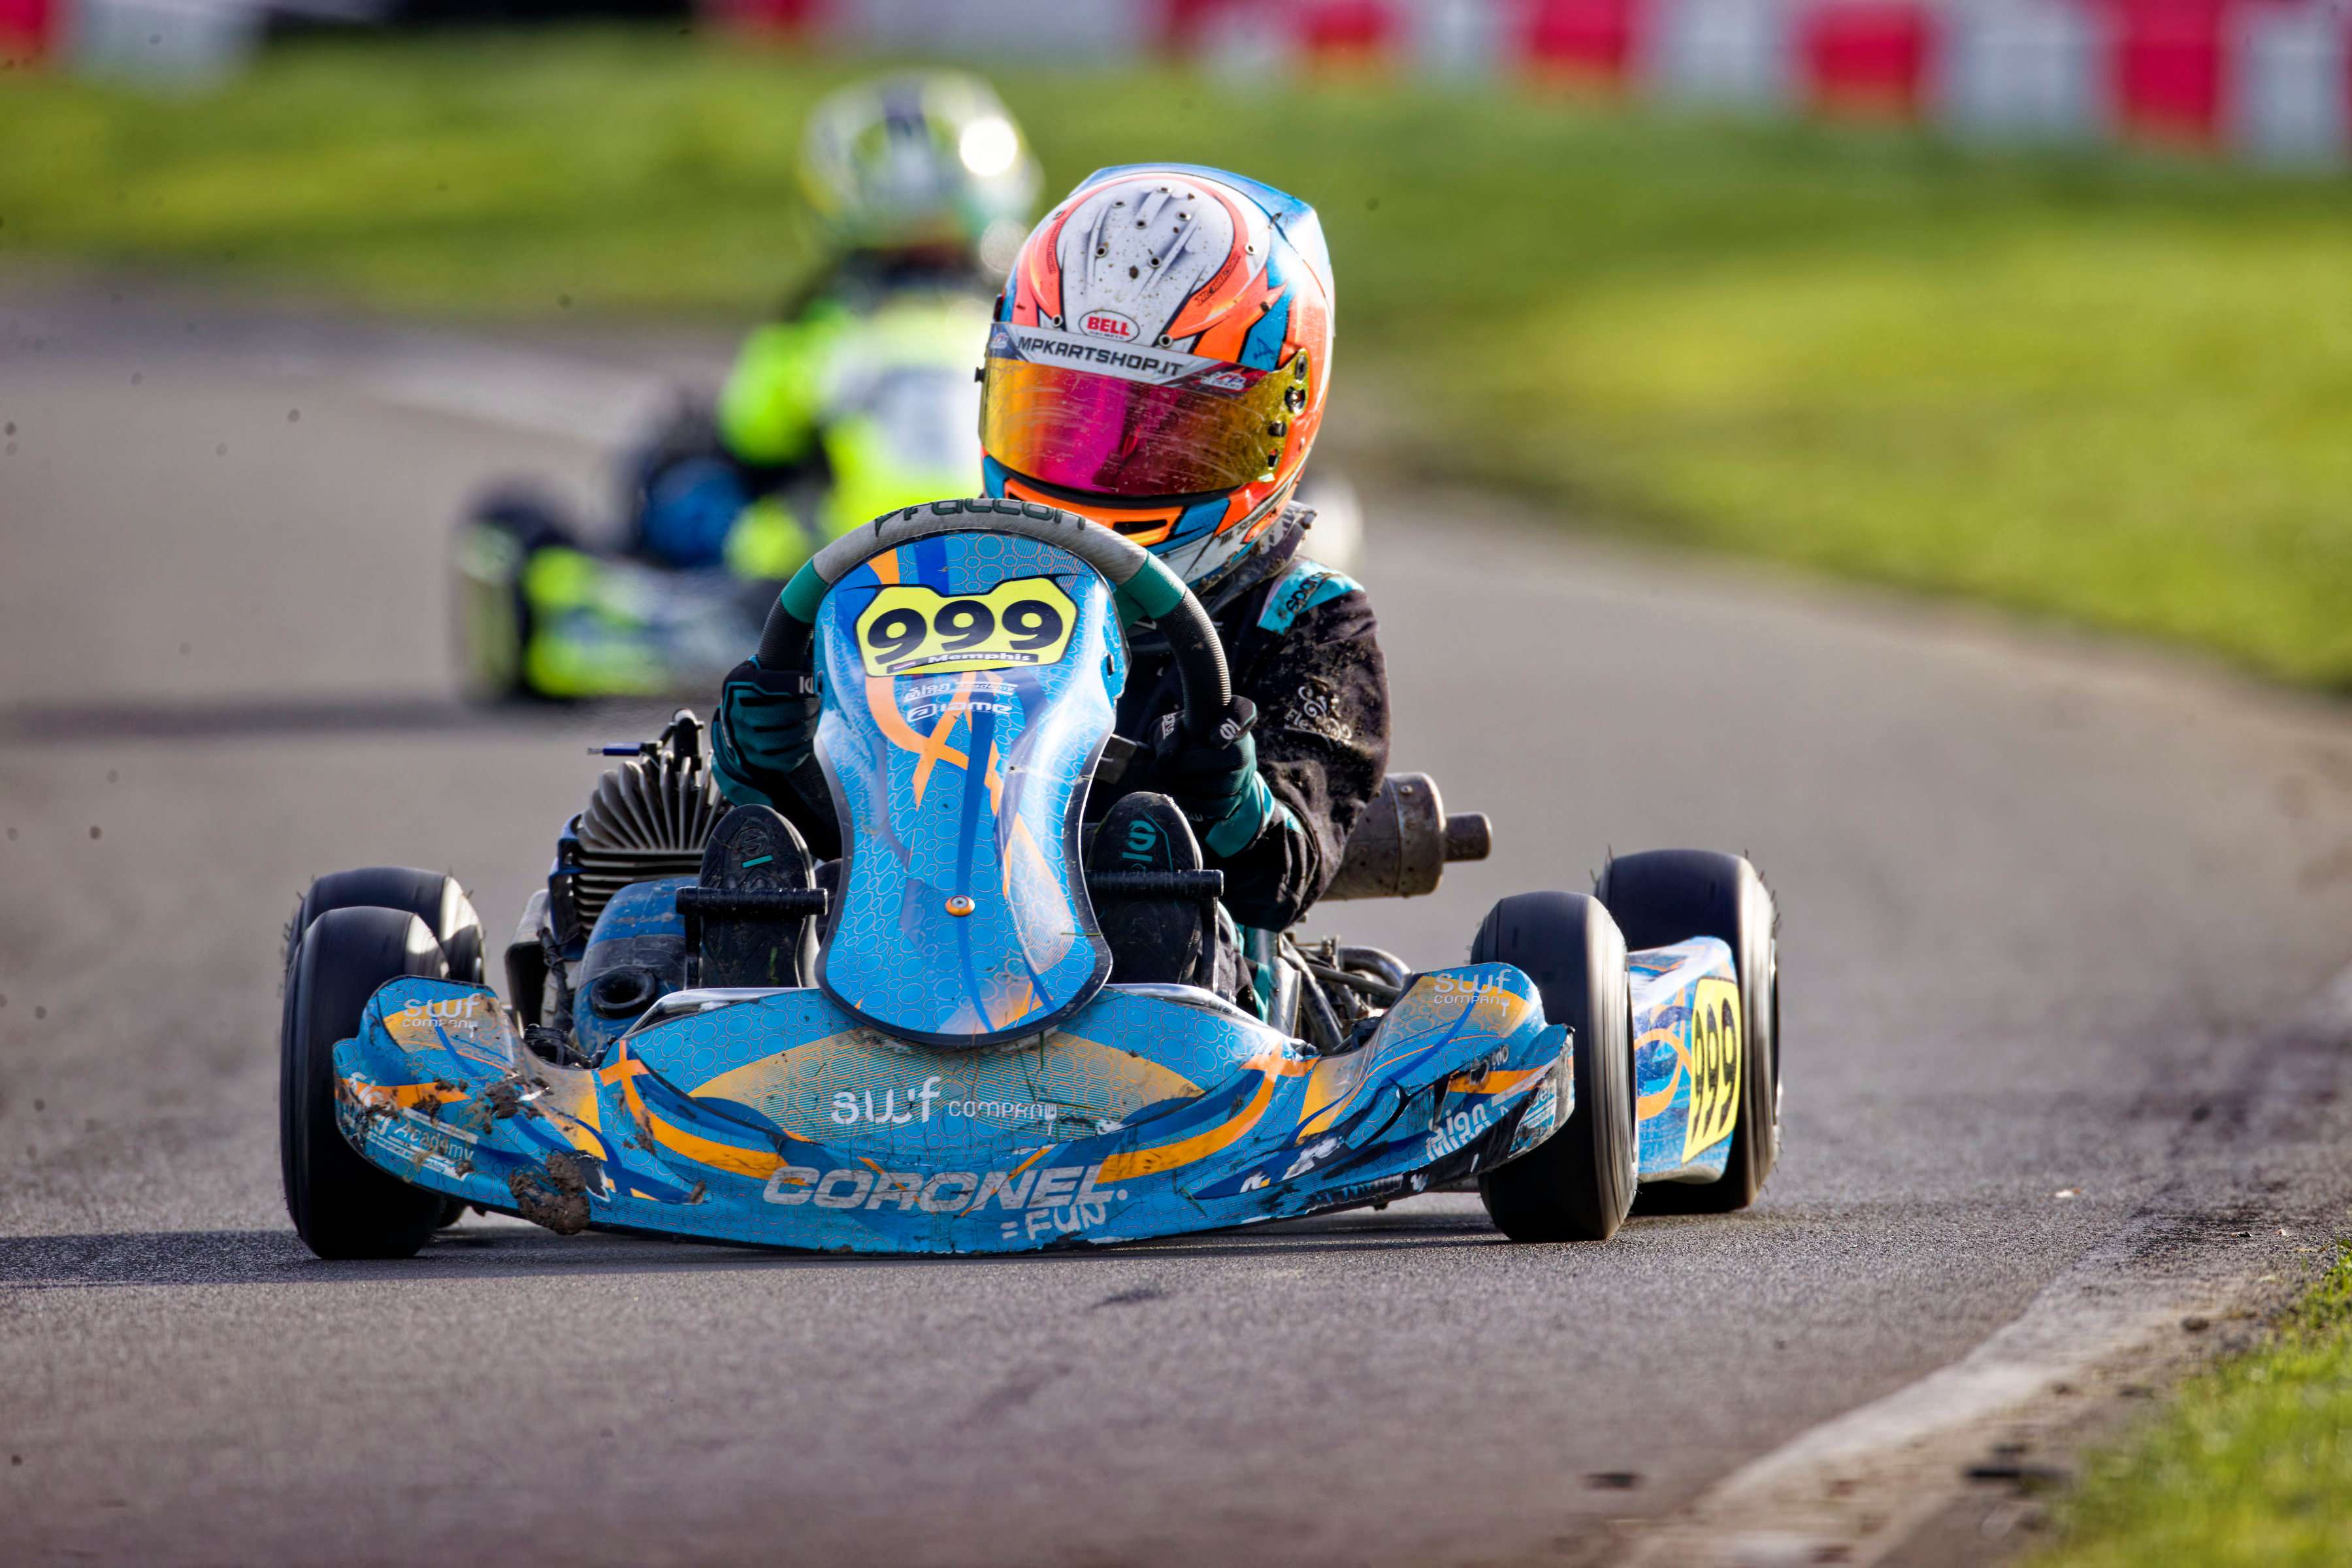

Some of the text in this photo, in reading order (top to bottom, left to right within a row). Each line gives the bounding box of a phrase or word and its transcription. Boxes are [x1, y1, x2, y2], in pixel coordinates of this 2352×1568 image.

[1087, 316, 1130, 336] BELL
[1018, 336, 1183, 376] MPKARTSHOP.IT
[868, 600, 1063, 664] 999
[928, 653, 1030, 664] Memphis
[1691, 997, 1737, 1145] 999
